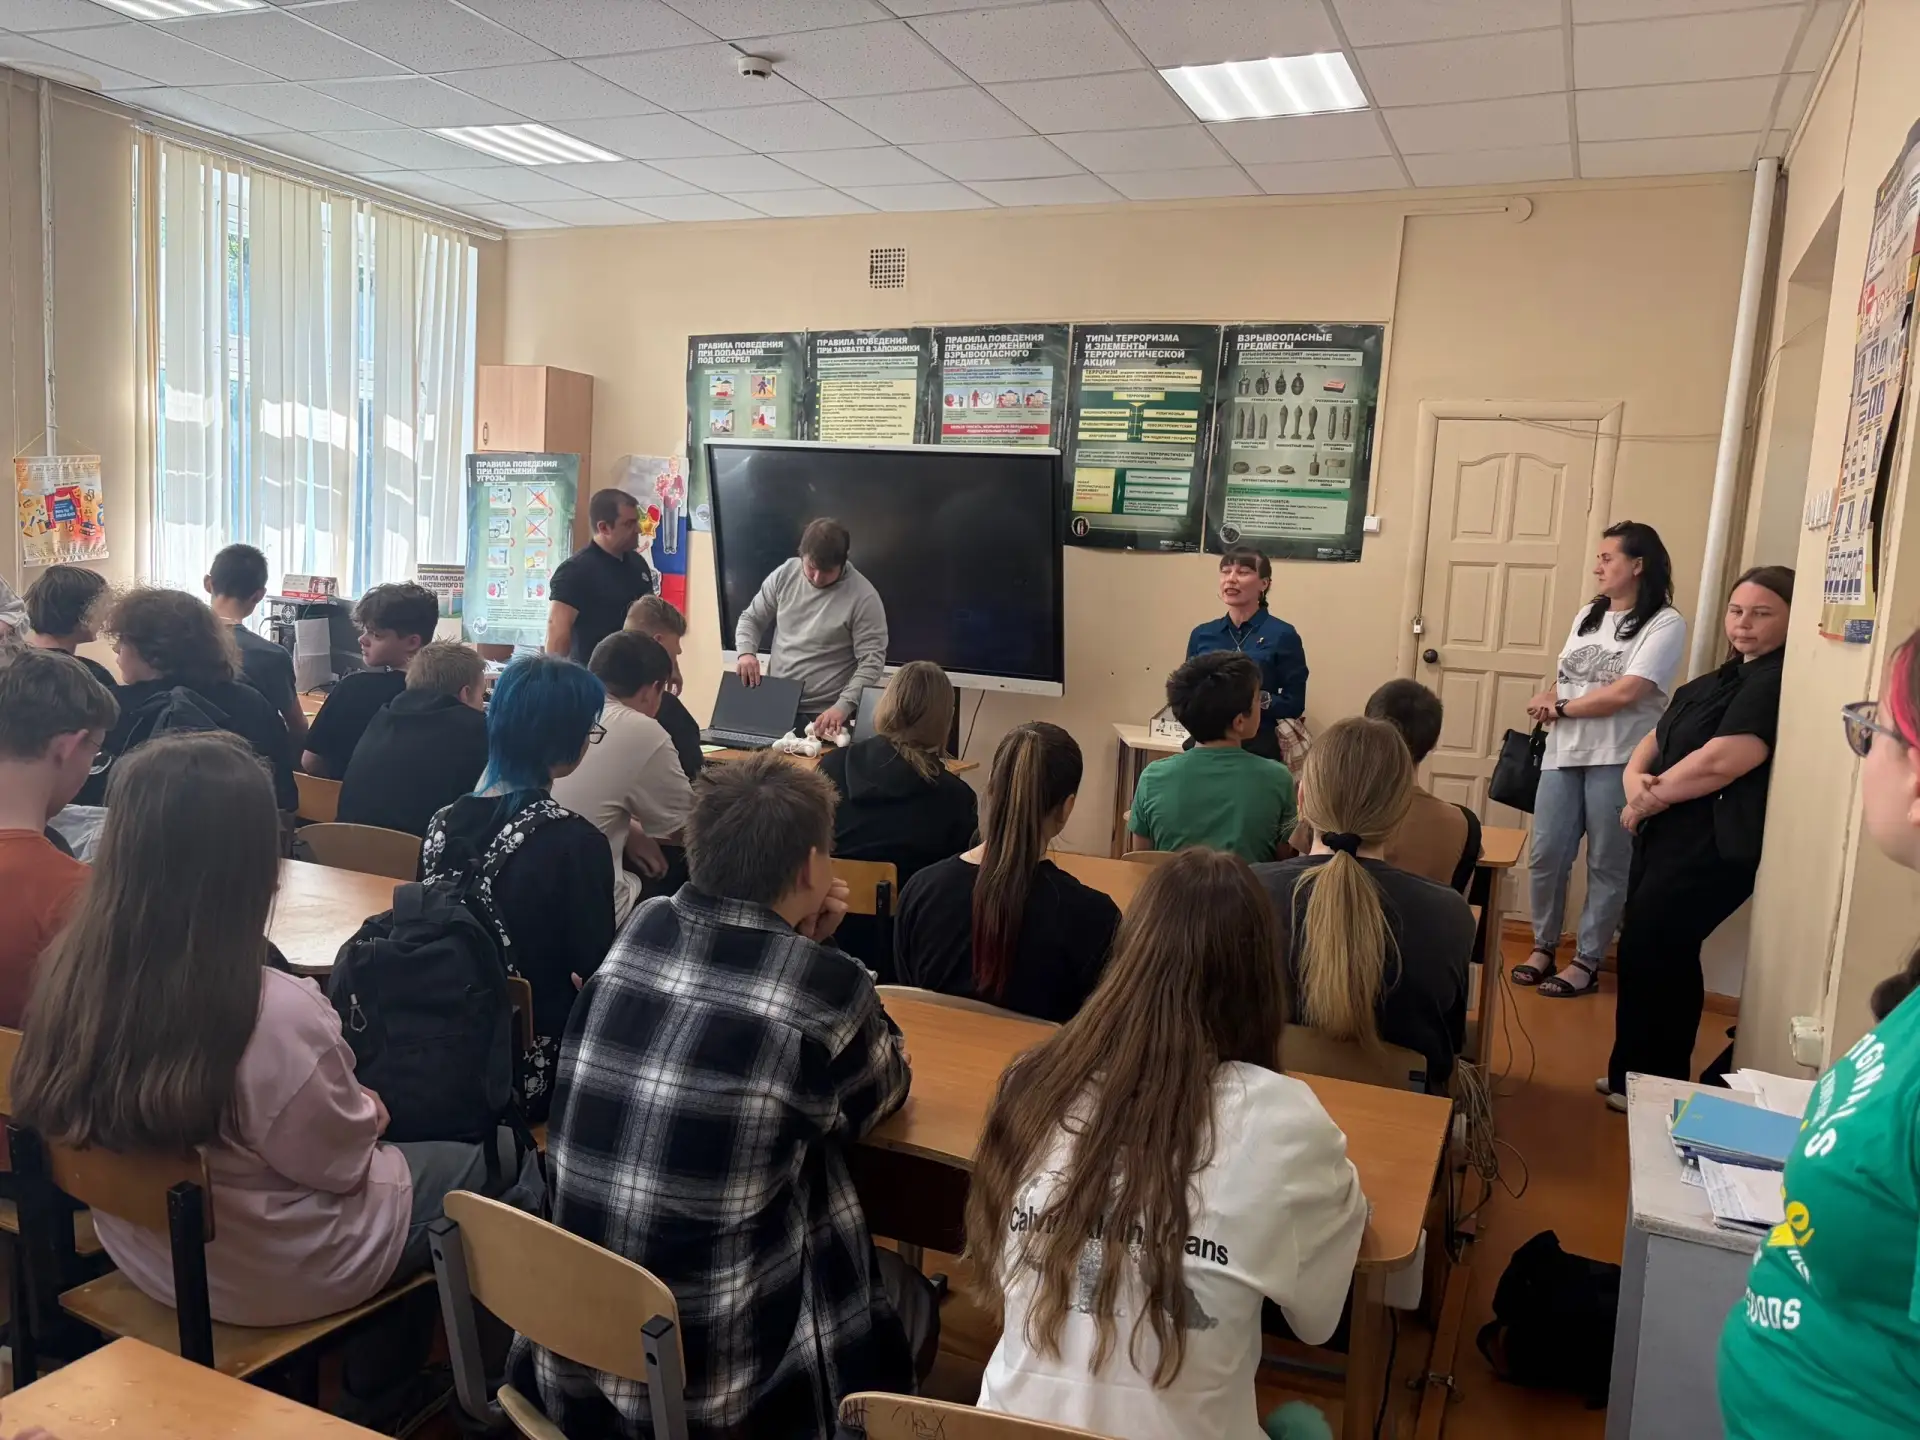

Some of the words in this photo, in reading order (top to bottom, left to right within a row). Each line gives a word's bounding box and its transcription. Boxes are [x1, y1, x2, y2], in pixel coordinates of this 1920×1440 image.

[856, 337, 908, 346] ПОВЕДЕНИЯ
[945, 336, 986, 344] ПРАВИЛА
[988, 334, 1044, 343] ПОВЕДЕНИЯ
[1086, 334, 1114, 342] ТИПЫ
[1115, 333, 1179, 342] ТЕРРОРИЗМА
[1237, 333, 1333, 342] ВЗРЫВООПАСНЫЕ
[698, 342, 733, 350] ПРАВИЛА
[734, 341, 784, 349] ПОВЕДЕНИЯ
[833, 346, 865, 354] ЗАХВАТЕ
[872, 344, 920, 353] ЗАЛОЖНИКИ
[944, 344, 962, 352] ПРИ
[964, 342, 1033, 351] ОБНАРУЖЕНИИ
[1085, 342, 1092, 350] И
[1094, 342, 1147, 350] ЭЛЕМЕНТЫ
[1236, 342, 1294, 351] ПРЕДМЕТЫ
[944, 350, 1029, 359] ВЗРЫВООПАСНОГО
[1084, 349, 1185, 358] ТЕРРОРИСТИЧЕСКОЙ
[697, 357, 714, 365] ПОД
[715, 356, 751, 364] ОБСТРЕЛ
[943, 359, 991, 367] ПРЕДМЕТА
[1083, 358, 1116, 367] АКЦИИ
[512, 460, 558, 468] ПОВЕДЕНИЯ
[1185, 1235, 1229, 1266] ans
